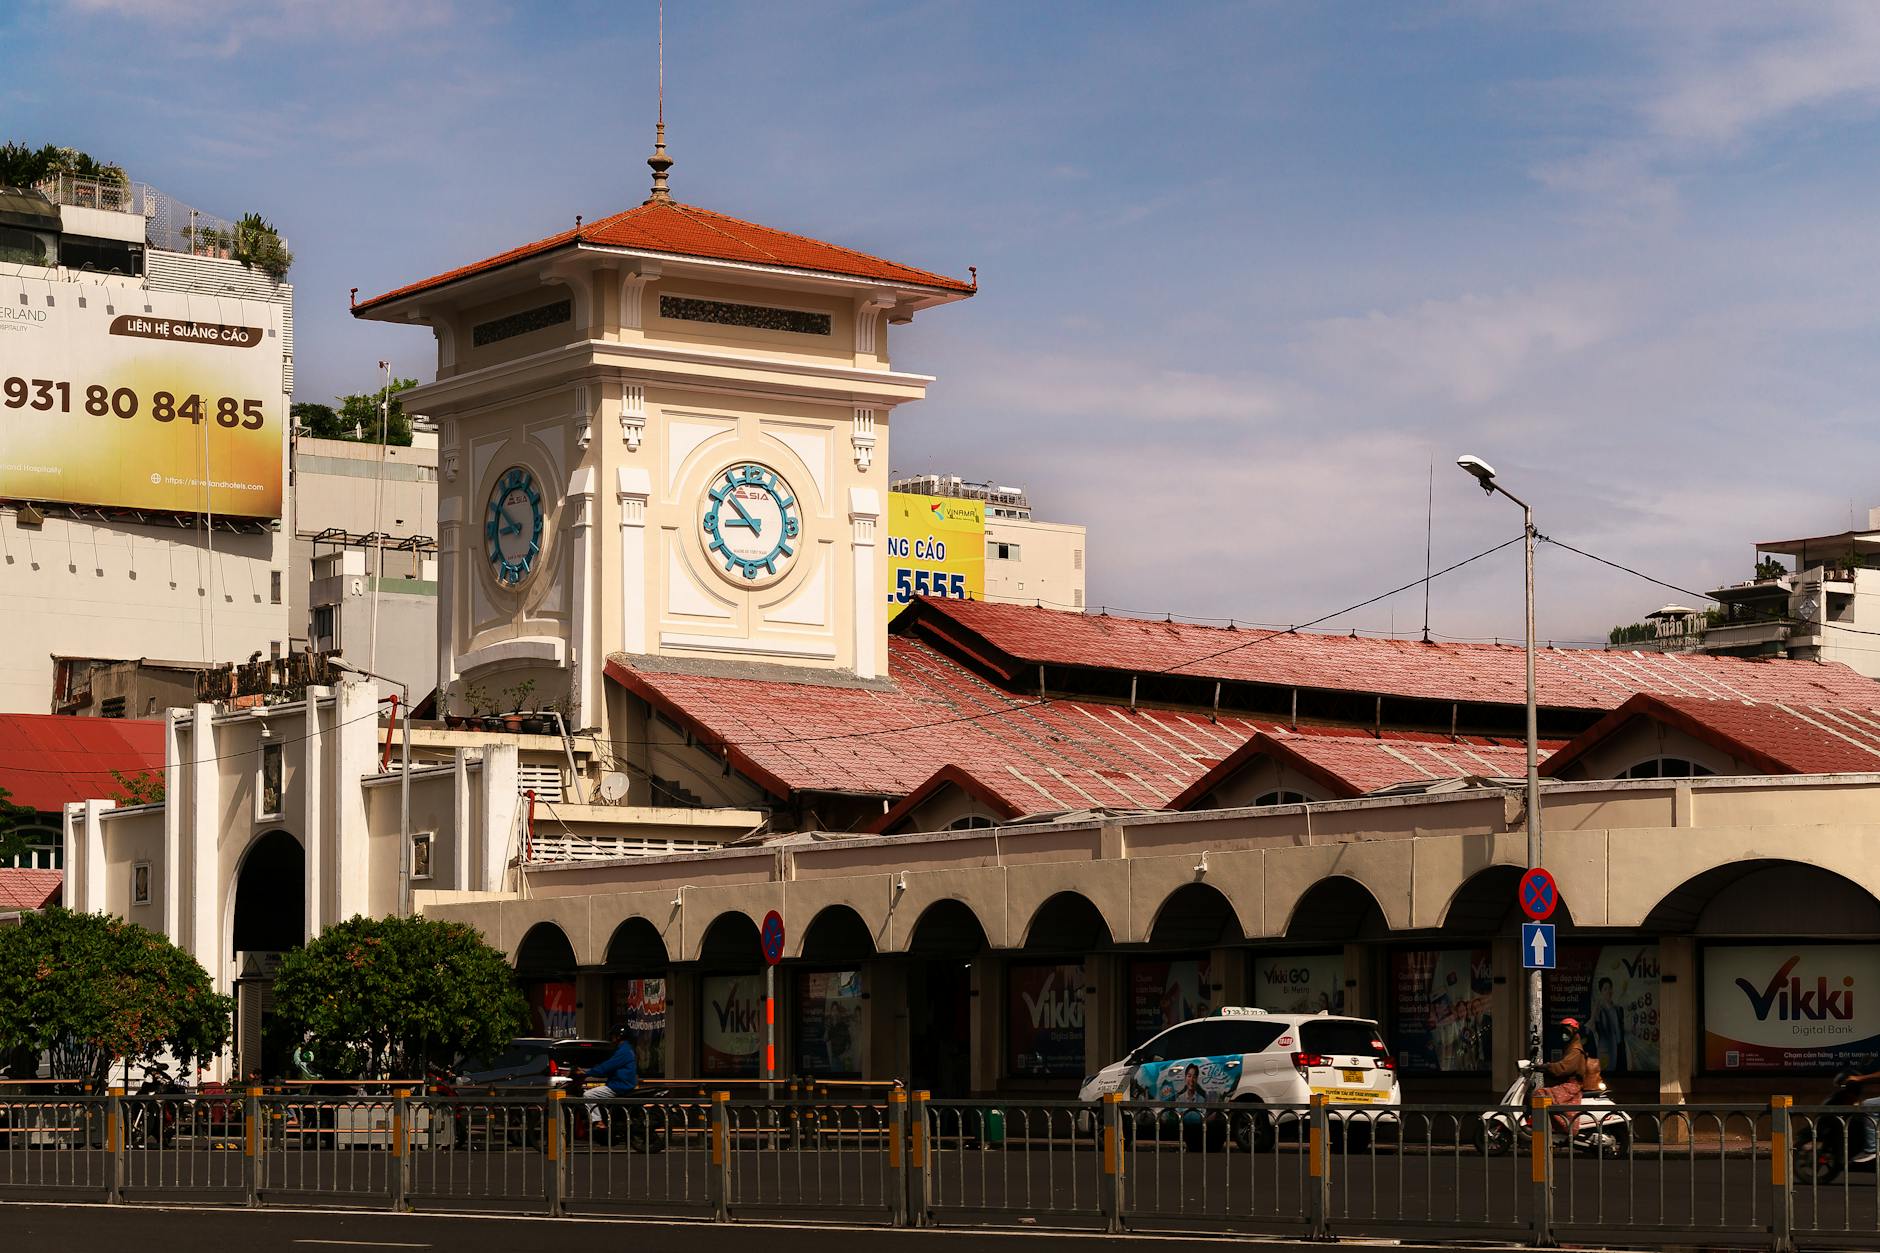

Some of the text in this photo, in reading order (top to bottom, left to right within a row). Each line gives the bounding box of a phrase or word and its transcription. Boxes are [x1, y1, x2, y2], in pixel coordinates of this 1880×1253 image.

[127, 319, 249, 343] LIÊN HỆ QUẢNG CÁO
[3, 377, 264, 430] 931 80 84 85
[744, 465, 765, 485] 12
[703, 511, 719, 534] 9
[916, 536, 946, 561] CÁO
[743, 563, 757, 580] 6
[1289, 968, 1311, 985] GO
[1735, 955, 1854, 1020] Vikki
[1792, 1024, 1855, 1037] Digital Bank
